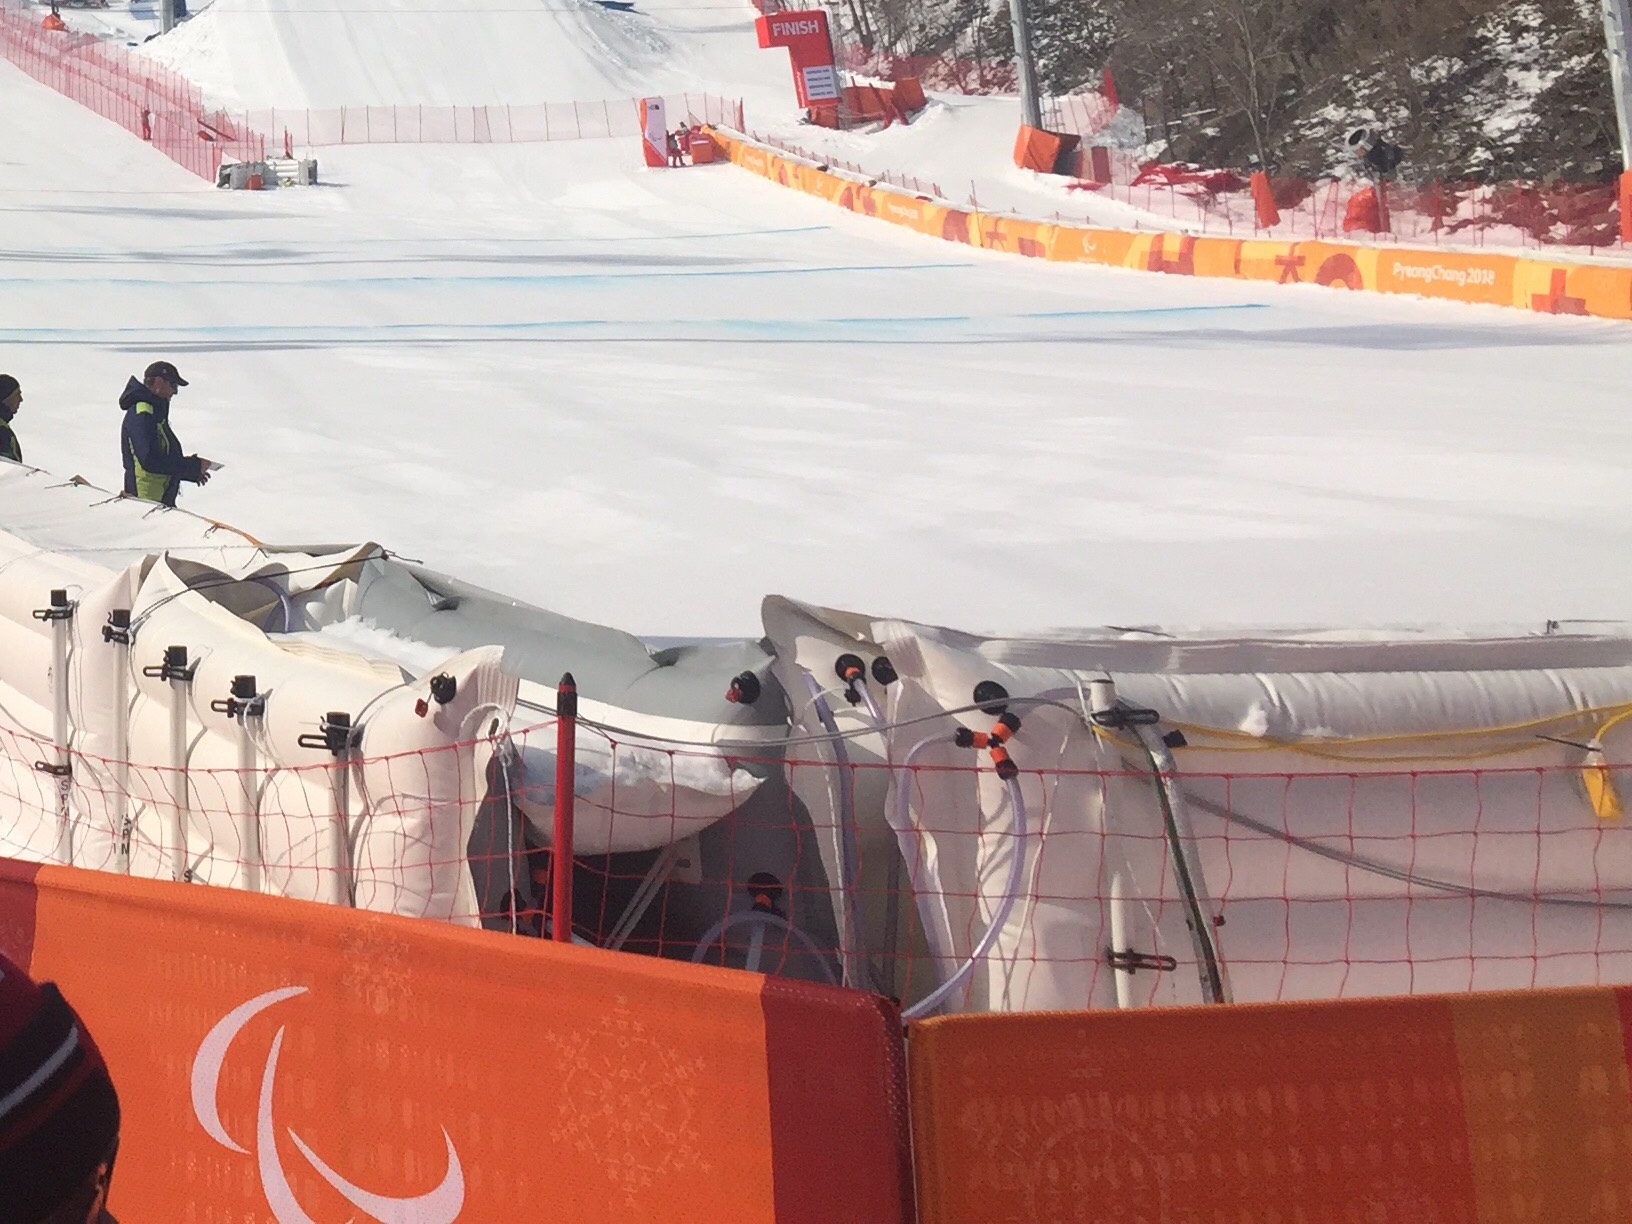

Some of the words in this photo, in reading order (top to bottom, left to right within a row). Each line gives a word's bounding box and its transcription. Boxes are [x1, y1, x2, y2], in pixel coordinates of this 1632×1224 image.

[772, 19, 820, 37] FINISH
[1392, 262, 1467, 287] PyeongChang
[1467, 267, 1496, 286] 2018
